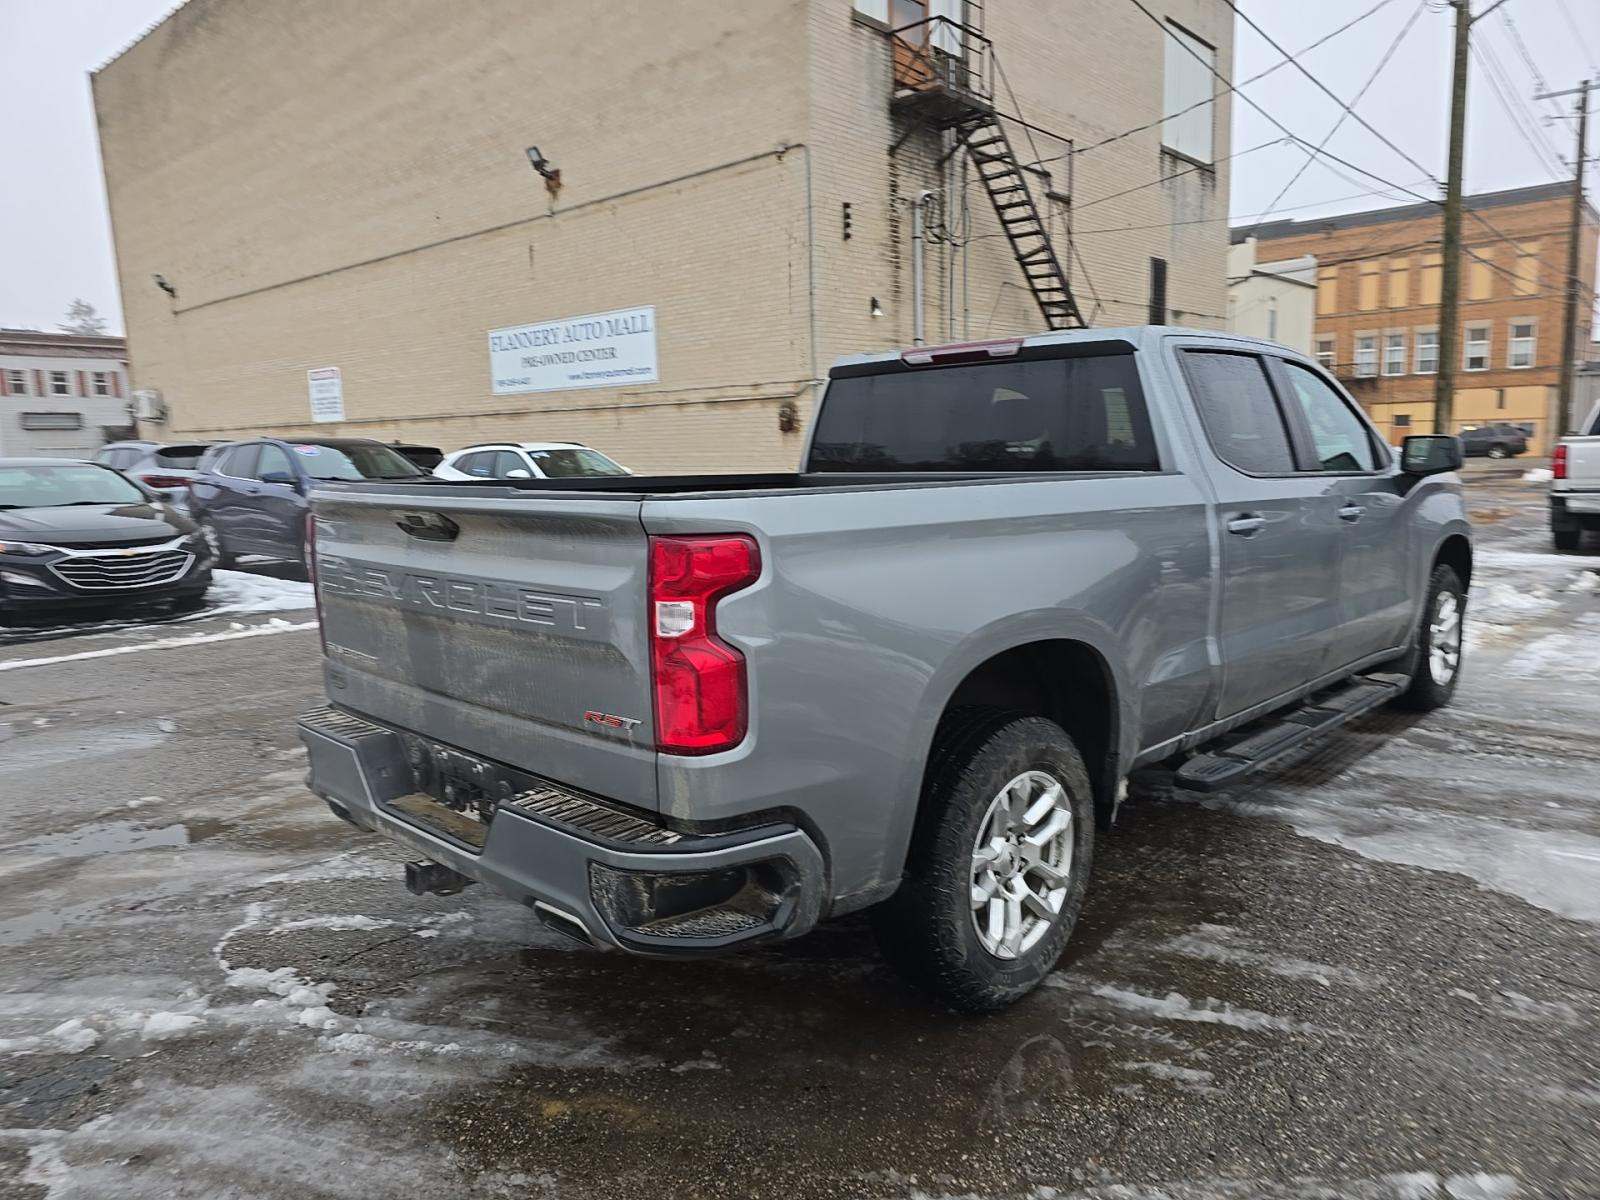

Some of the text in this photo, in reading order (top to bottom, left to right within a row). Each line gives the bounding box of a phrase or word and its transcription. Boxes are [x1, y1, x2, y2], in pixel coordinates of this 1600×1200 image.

[491, 314, 651, 352] FLANNERY AUTO MALL
[521, 346, 618, 368] PRE-OWNED CENTER
[583, 710, 642, 730] RST
